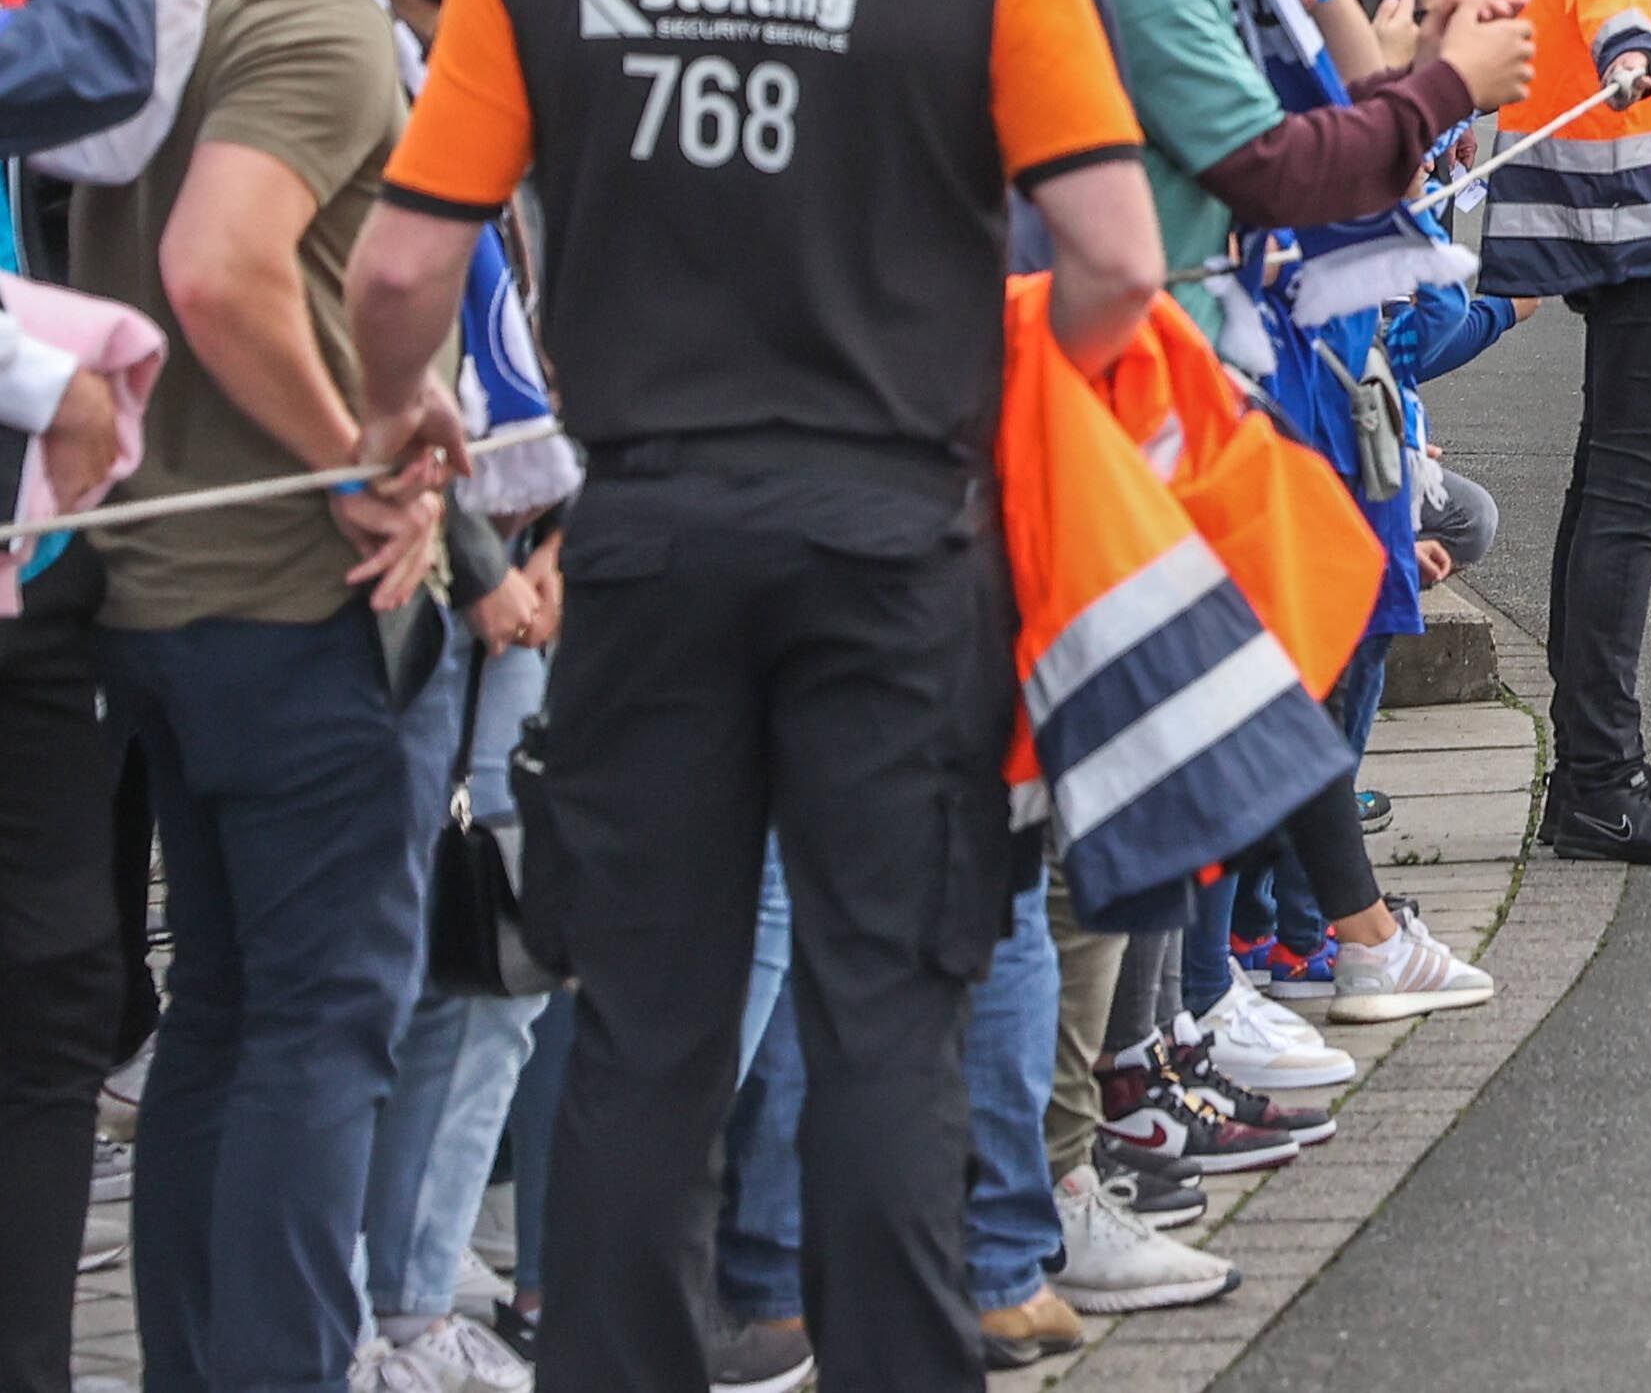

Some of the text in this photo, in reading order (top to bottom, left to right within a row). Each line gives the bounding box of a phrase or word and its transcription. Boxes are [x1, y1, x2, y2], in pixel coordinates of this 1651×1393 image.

[656, 16, 849, 53] SECURITY SERVICE
[622, 52, 800, 174] 768
